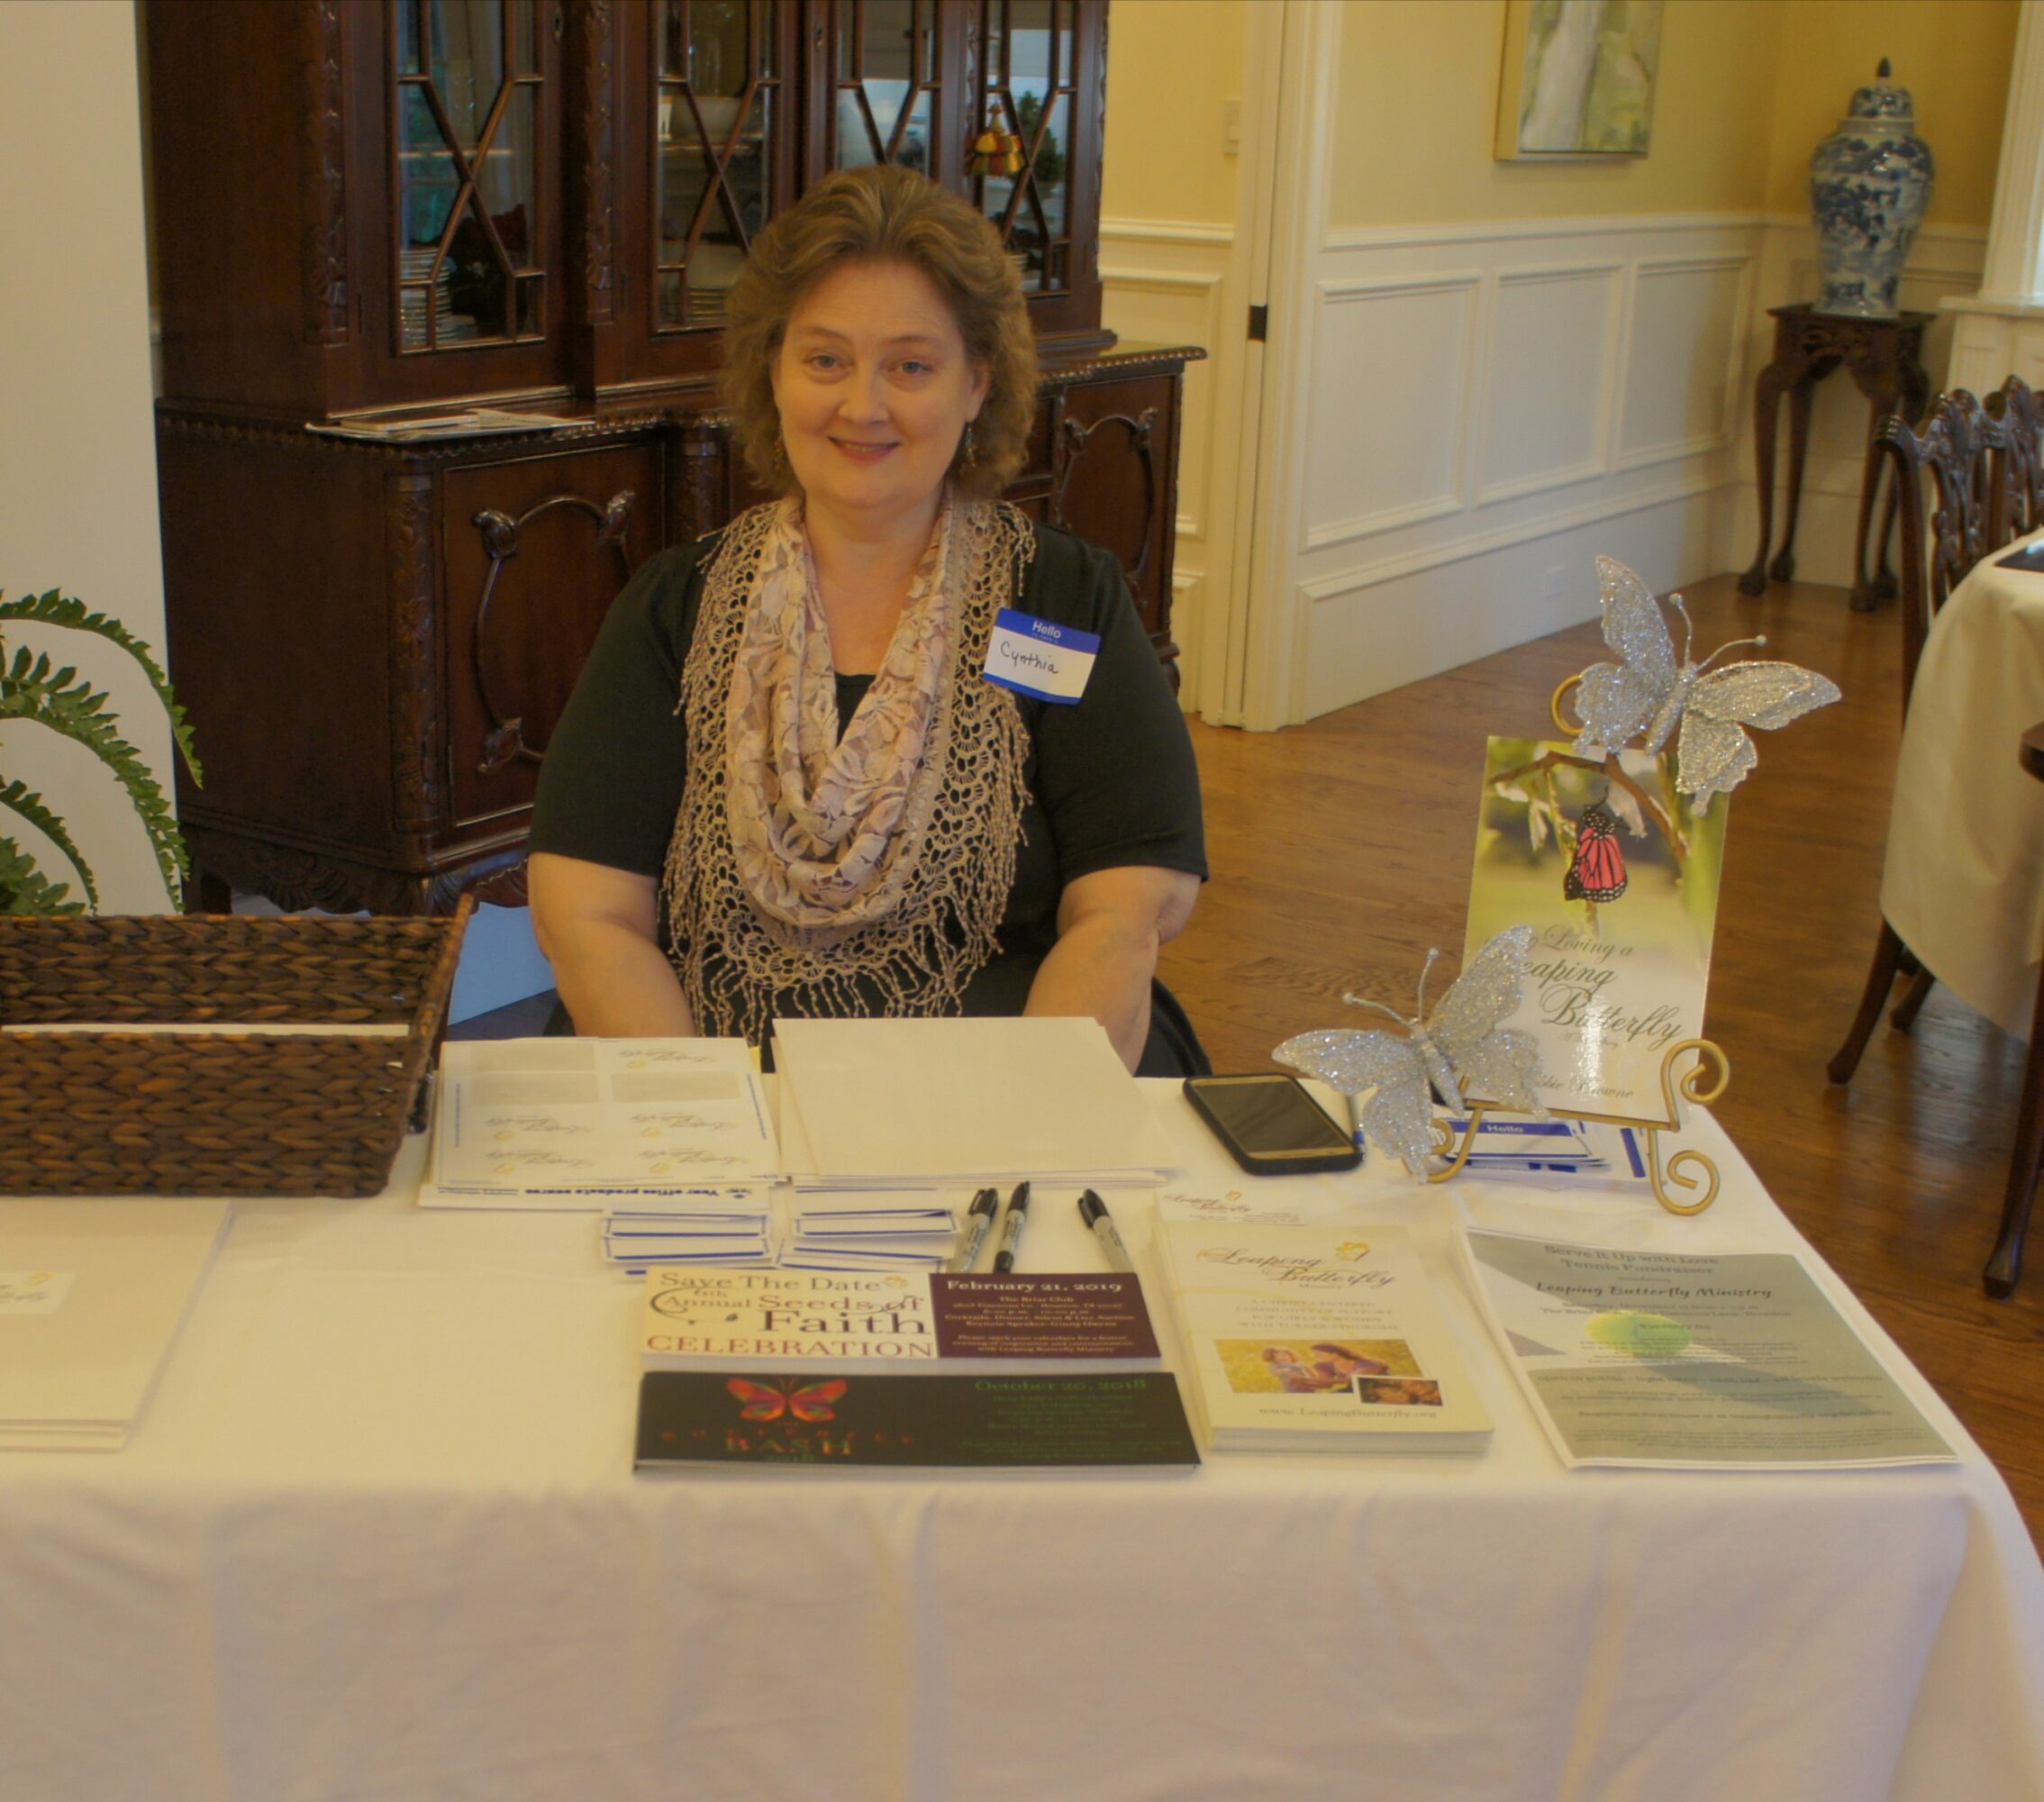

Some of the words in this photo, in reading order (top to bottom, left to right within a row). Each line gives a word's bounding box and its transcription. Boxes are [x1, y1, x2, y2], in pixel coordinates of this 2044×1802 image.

[1031, 621, 1061, 639] Hello
[1000, 641, 1060, 674] Cynthia
[1542, 924, 1616, 963] Loving
[1620, 946, 1633, 957] a
[1522, 957, 1617, 996] eaping
[1486, 1124, 1523, 1133] Hello
[1196, 1247, 1323, 1267] Leaping
[1544, 1245, 1594, 1258] Serve
[1612, 1252, 1636, 1262] Up
[1639, 1254, 1676, 1262] with
[1261, 1264, 1394, 1288] Butterfly
[1560, 1259, 1619, 1270] Tennis
[1622, 1264, 1713, 1274] Fundraiser
[661, 1272, 732, 1289] Save
[739, 1276, 800, 1289] The
[810, 1277, 881, 1291] Date
[947, 1280, 1036, 1293] February
[1073, 1283, 1122, 1293] 2019
[1537, 1281, 1603, 1297] Leaping
[1609, 1286, 1690, 1298] Butterfly
[1695, 1287, 1772, 1298] Ministry
[664, 1297, 751, 1308] Annual
[759, 1295, 876, 1311] Seeds
[885, 1295, 924, 1311] of
[758, 1309, 931, 1335] Faith
[647, 1335, 933, 1358] CELEBRATION
[975, 1380, 1056, 1391] October
[725, 1437, 852, 1456] BASH
